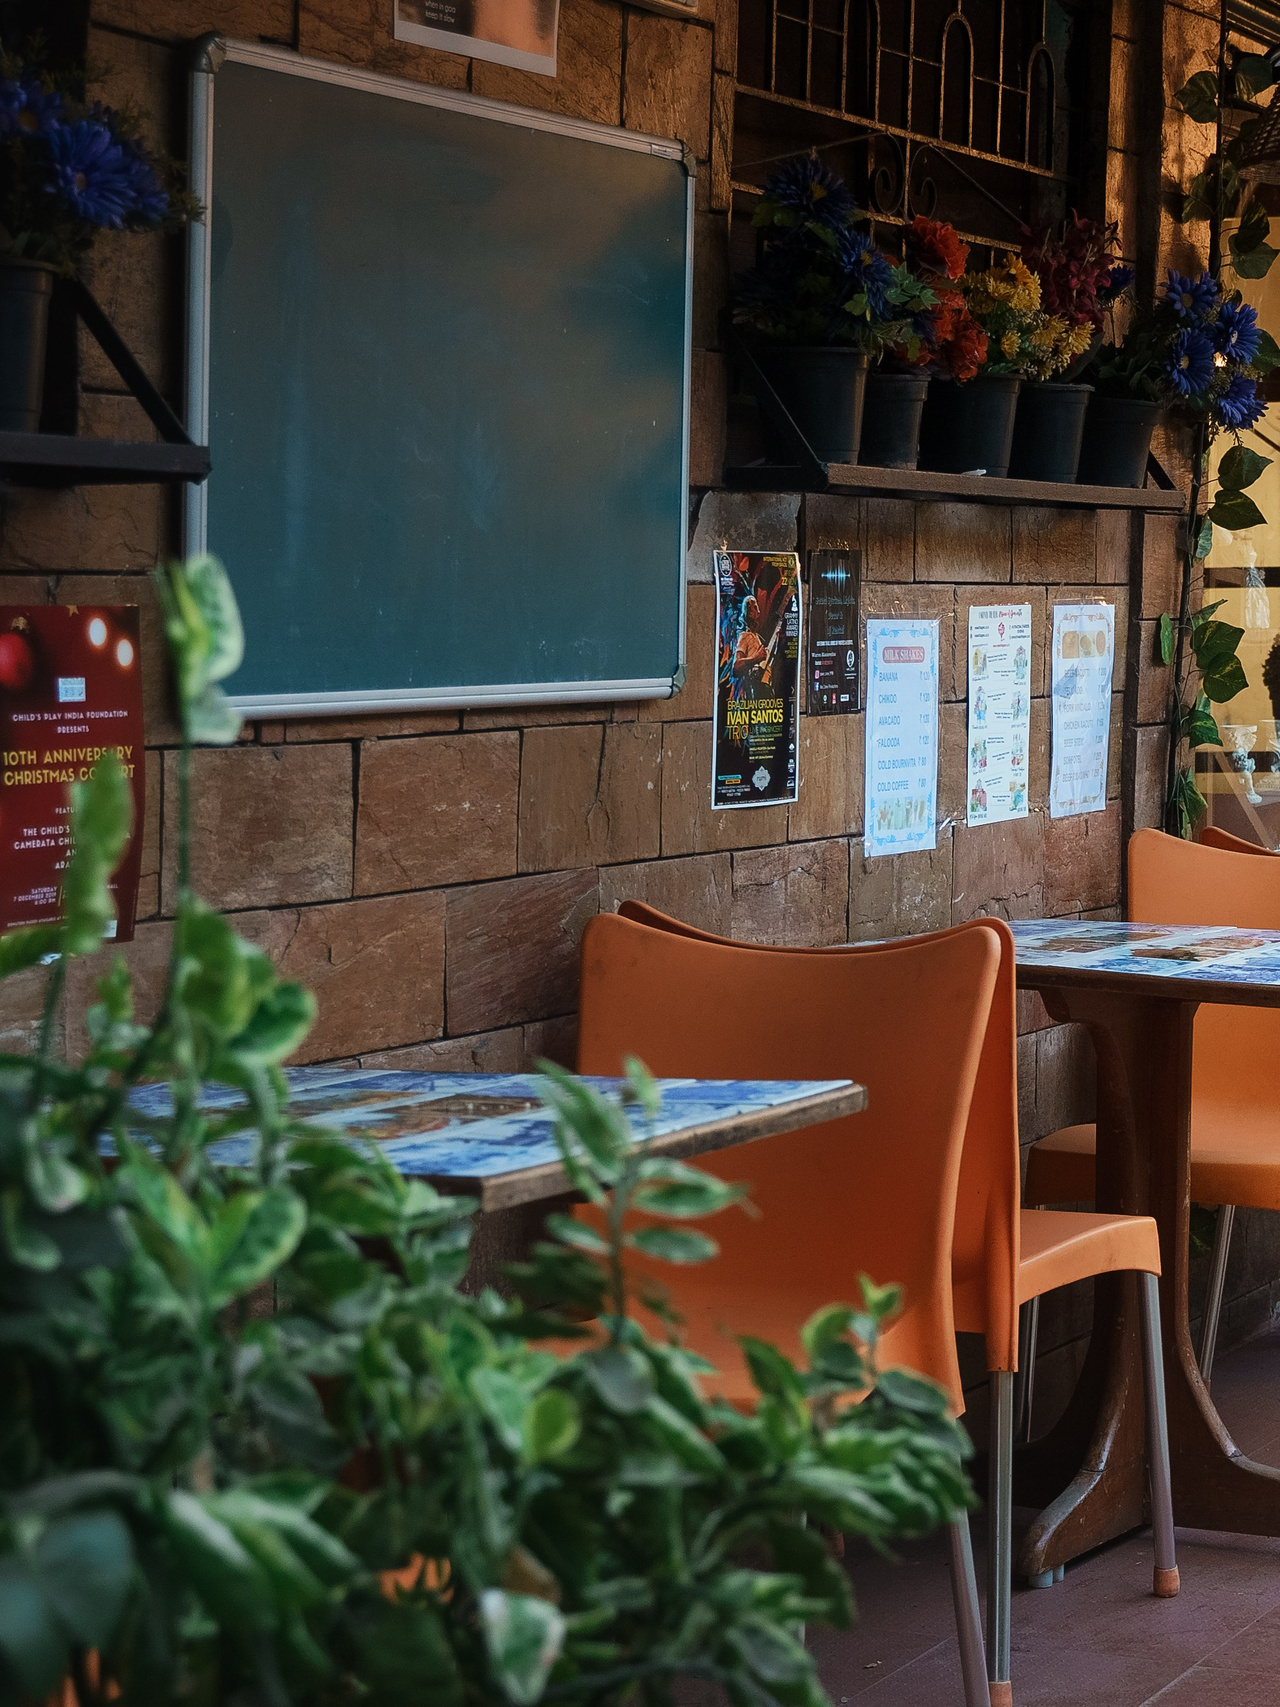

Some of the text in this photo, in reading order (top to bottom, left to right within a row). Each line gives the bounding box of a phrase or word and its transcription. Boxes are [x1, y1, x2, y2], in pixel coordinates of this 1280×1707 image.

[444, 14, 456, 22] slow
[884, 649, 924, 661] MILK SHAKES
[879, 672, 898, 682] BANANA
[728, 698, 784, 710] BRAZILIAN GROOVES
[879, 694, 897, 704] CHIKOO
[12, 710, 128, 722] CHILD'S PLAY INDIA FOUNDATION
[727, 709, 784, 725] IVAN SANTOS
[57, 725, 90, 734] PRESENTS
[725, 725, 749, 739] TRIO
[878, 737, 900, 748] FALOODA
[3, 745, 133, 766] 10TH ANNIVERSRY
[878, 760, 891, 770] COLD
[892, 758, 917, 769] BOURNVITA
[4, 764, 135, 786] CHRISTMAS CORT
[877, 781, 891, 792] COLD
[892, 780, 909, 790] COFFEE
[23, 825, 70, 837] THE CHILD'S
[14, 838, 55, 850] CAMERATA
[18, 893, 44, 901] DECEMBER
